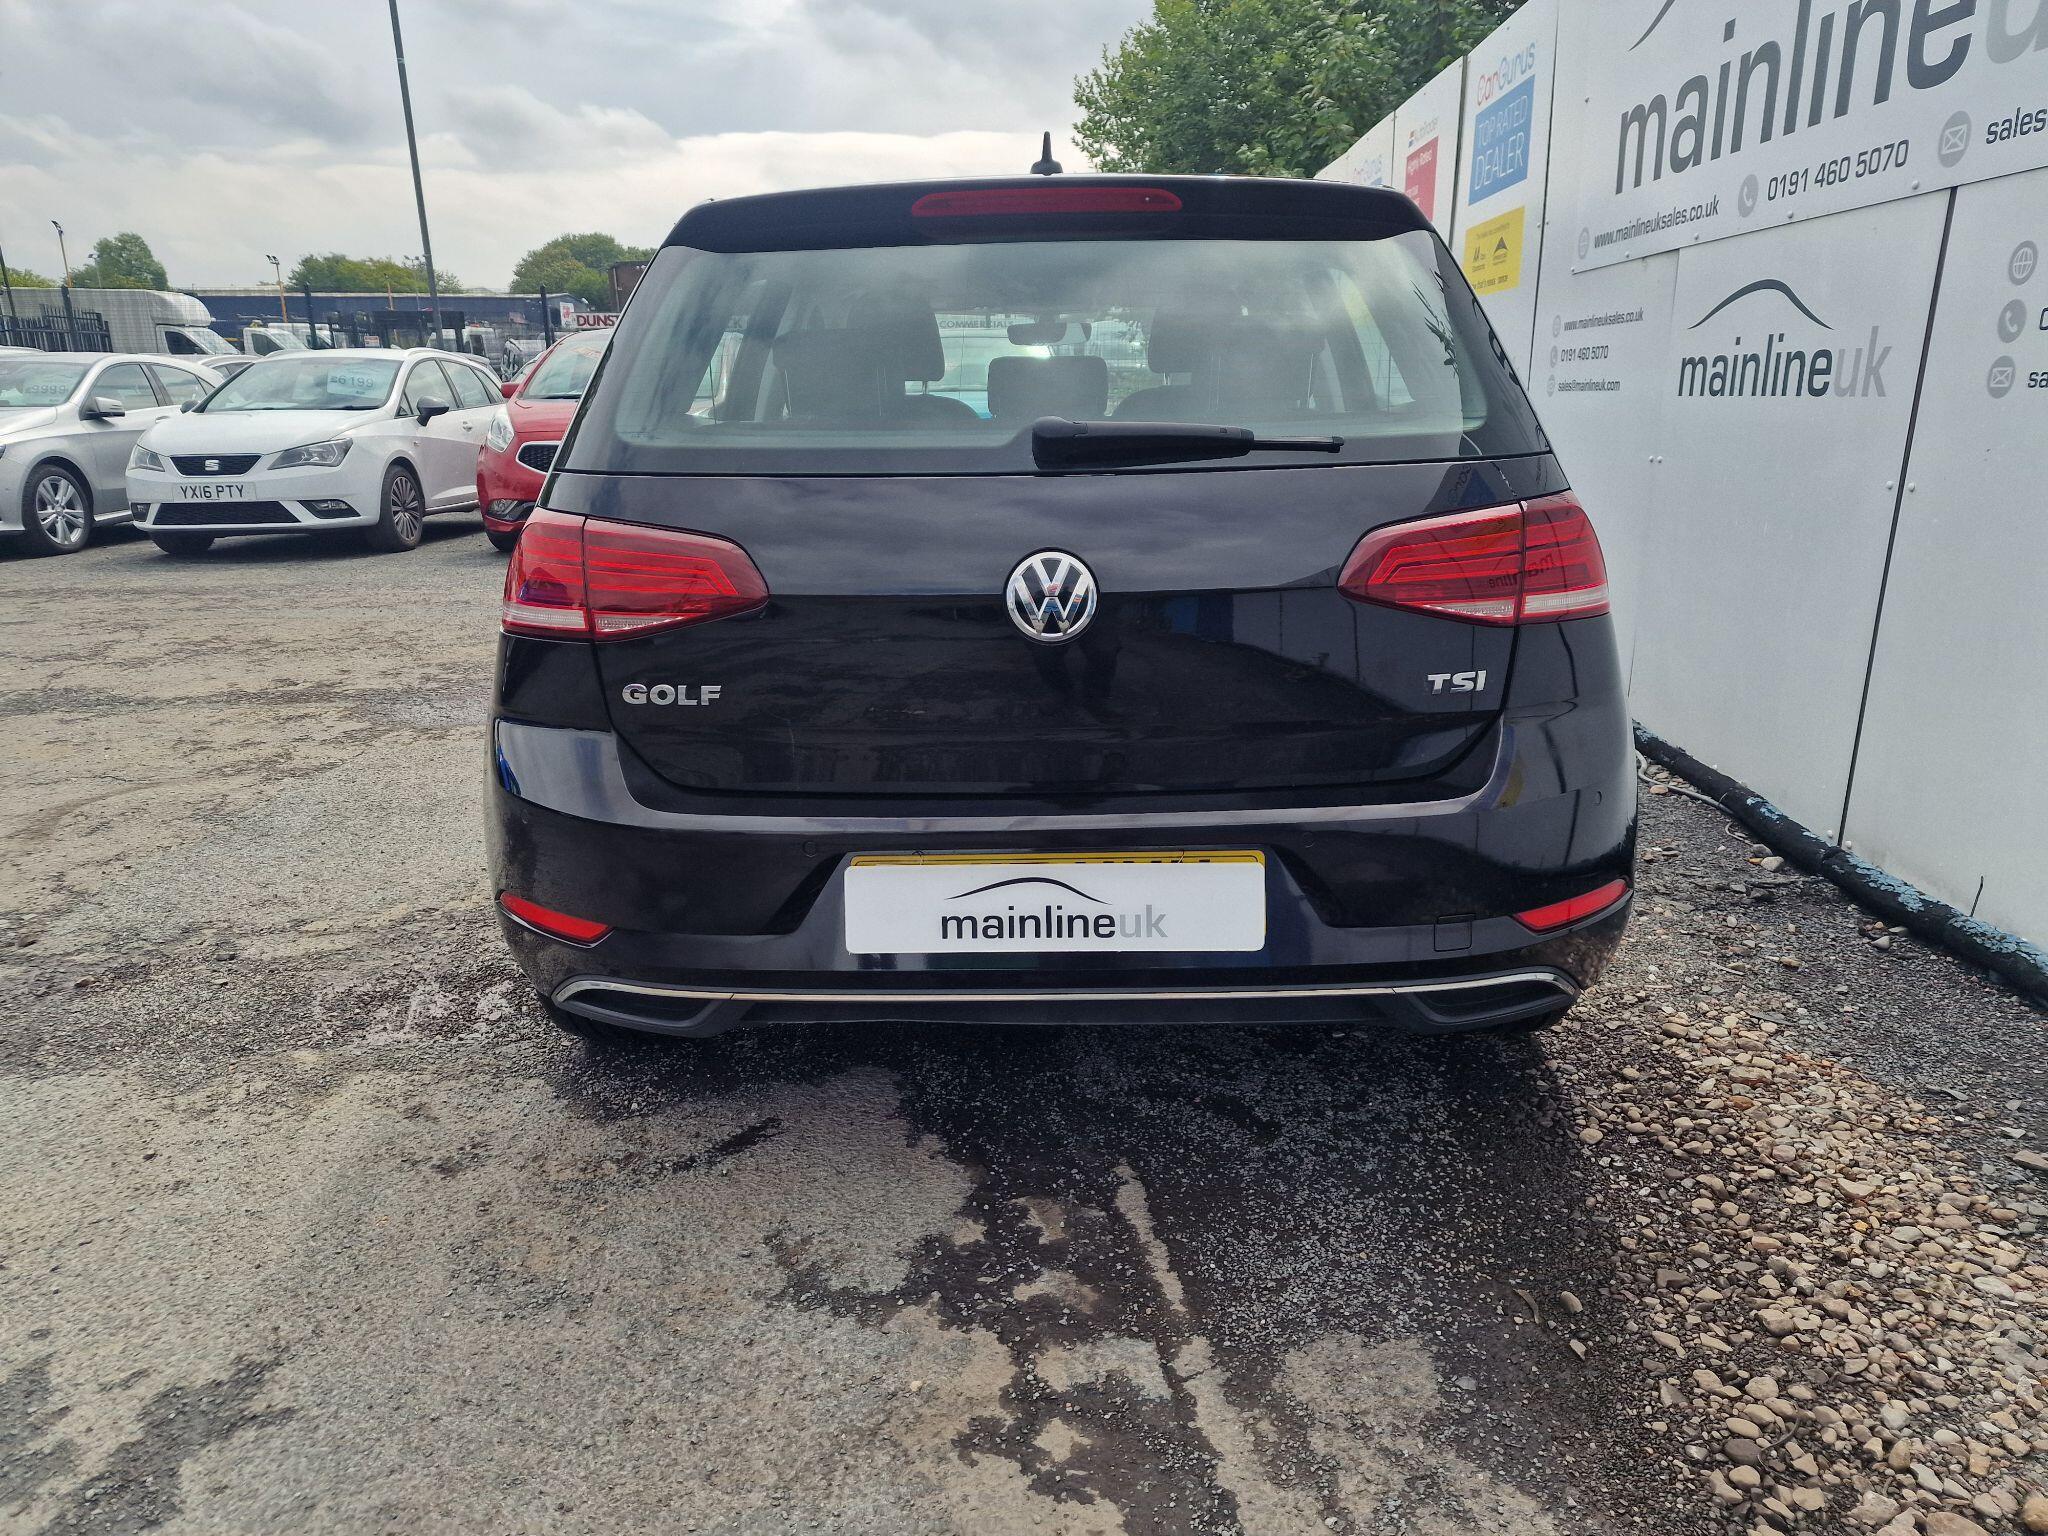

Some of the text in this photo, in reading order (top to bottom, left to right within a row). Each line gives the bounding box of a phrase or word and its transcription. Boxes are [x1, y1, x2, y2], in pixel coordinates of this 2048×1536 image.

[1498, 95, 1528, 137] RATED
[1474, 131, 1525, 191] DEALER
[1767, 139, 1910, 202] 0191 460 5070
[1594, 194, 1720, 249] www.mainlineuksales.co.uk
[1560, 345, 1609, 362] 0191 460 5070
[1677, 325, 1893, 397] mainlineuk
[180, 484, 244, 499] YX16 PTY
[621, 683, 722, 706] GOLF
[1427, 670, 1488, 695] TSI
[940, 904, 1168, 940] mainlineuk
